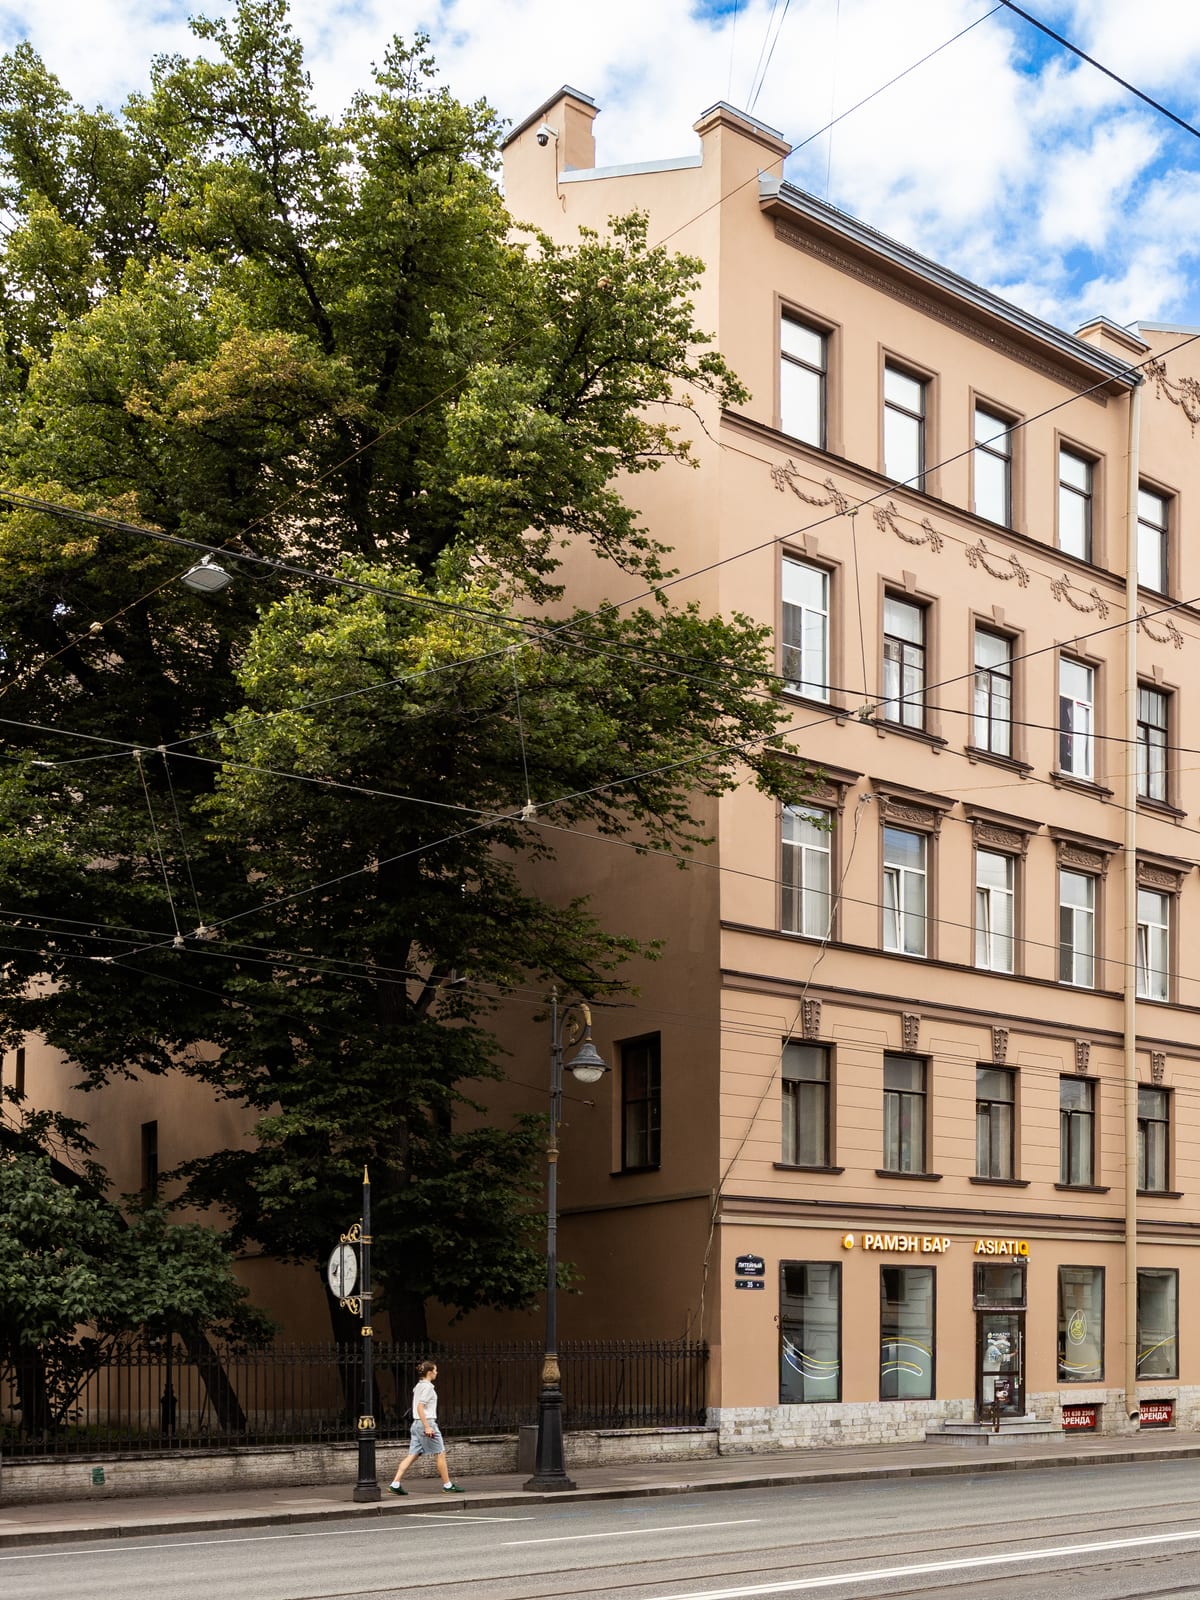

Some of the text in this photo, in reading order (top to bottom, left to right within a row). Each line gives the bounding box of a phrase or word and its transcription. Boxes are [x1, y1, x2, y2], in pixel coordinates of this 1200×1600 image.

[863, 1234, 951, 1254] РАМЭН БАР
[974, 1240, 1030, 1257] ASIATIQ
[1139, 1412, 1168, 1421] АРЕНДА
